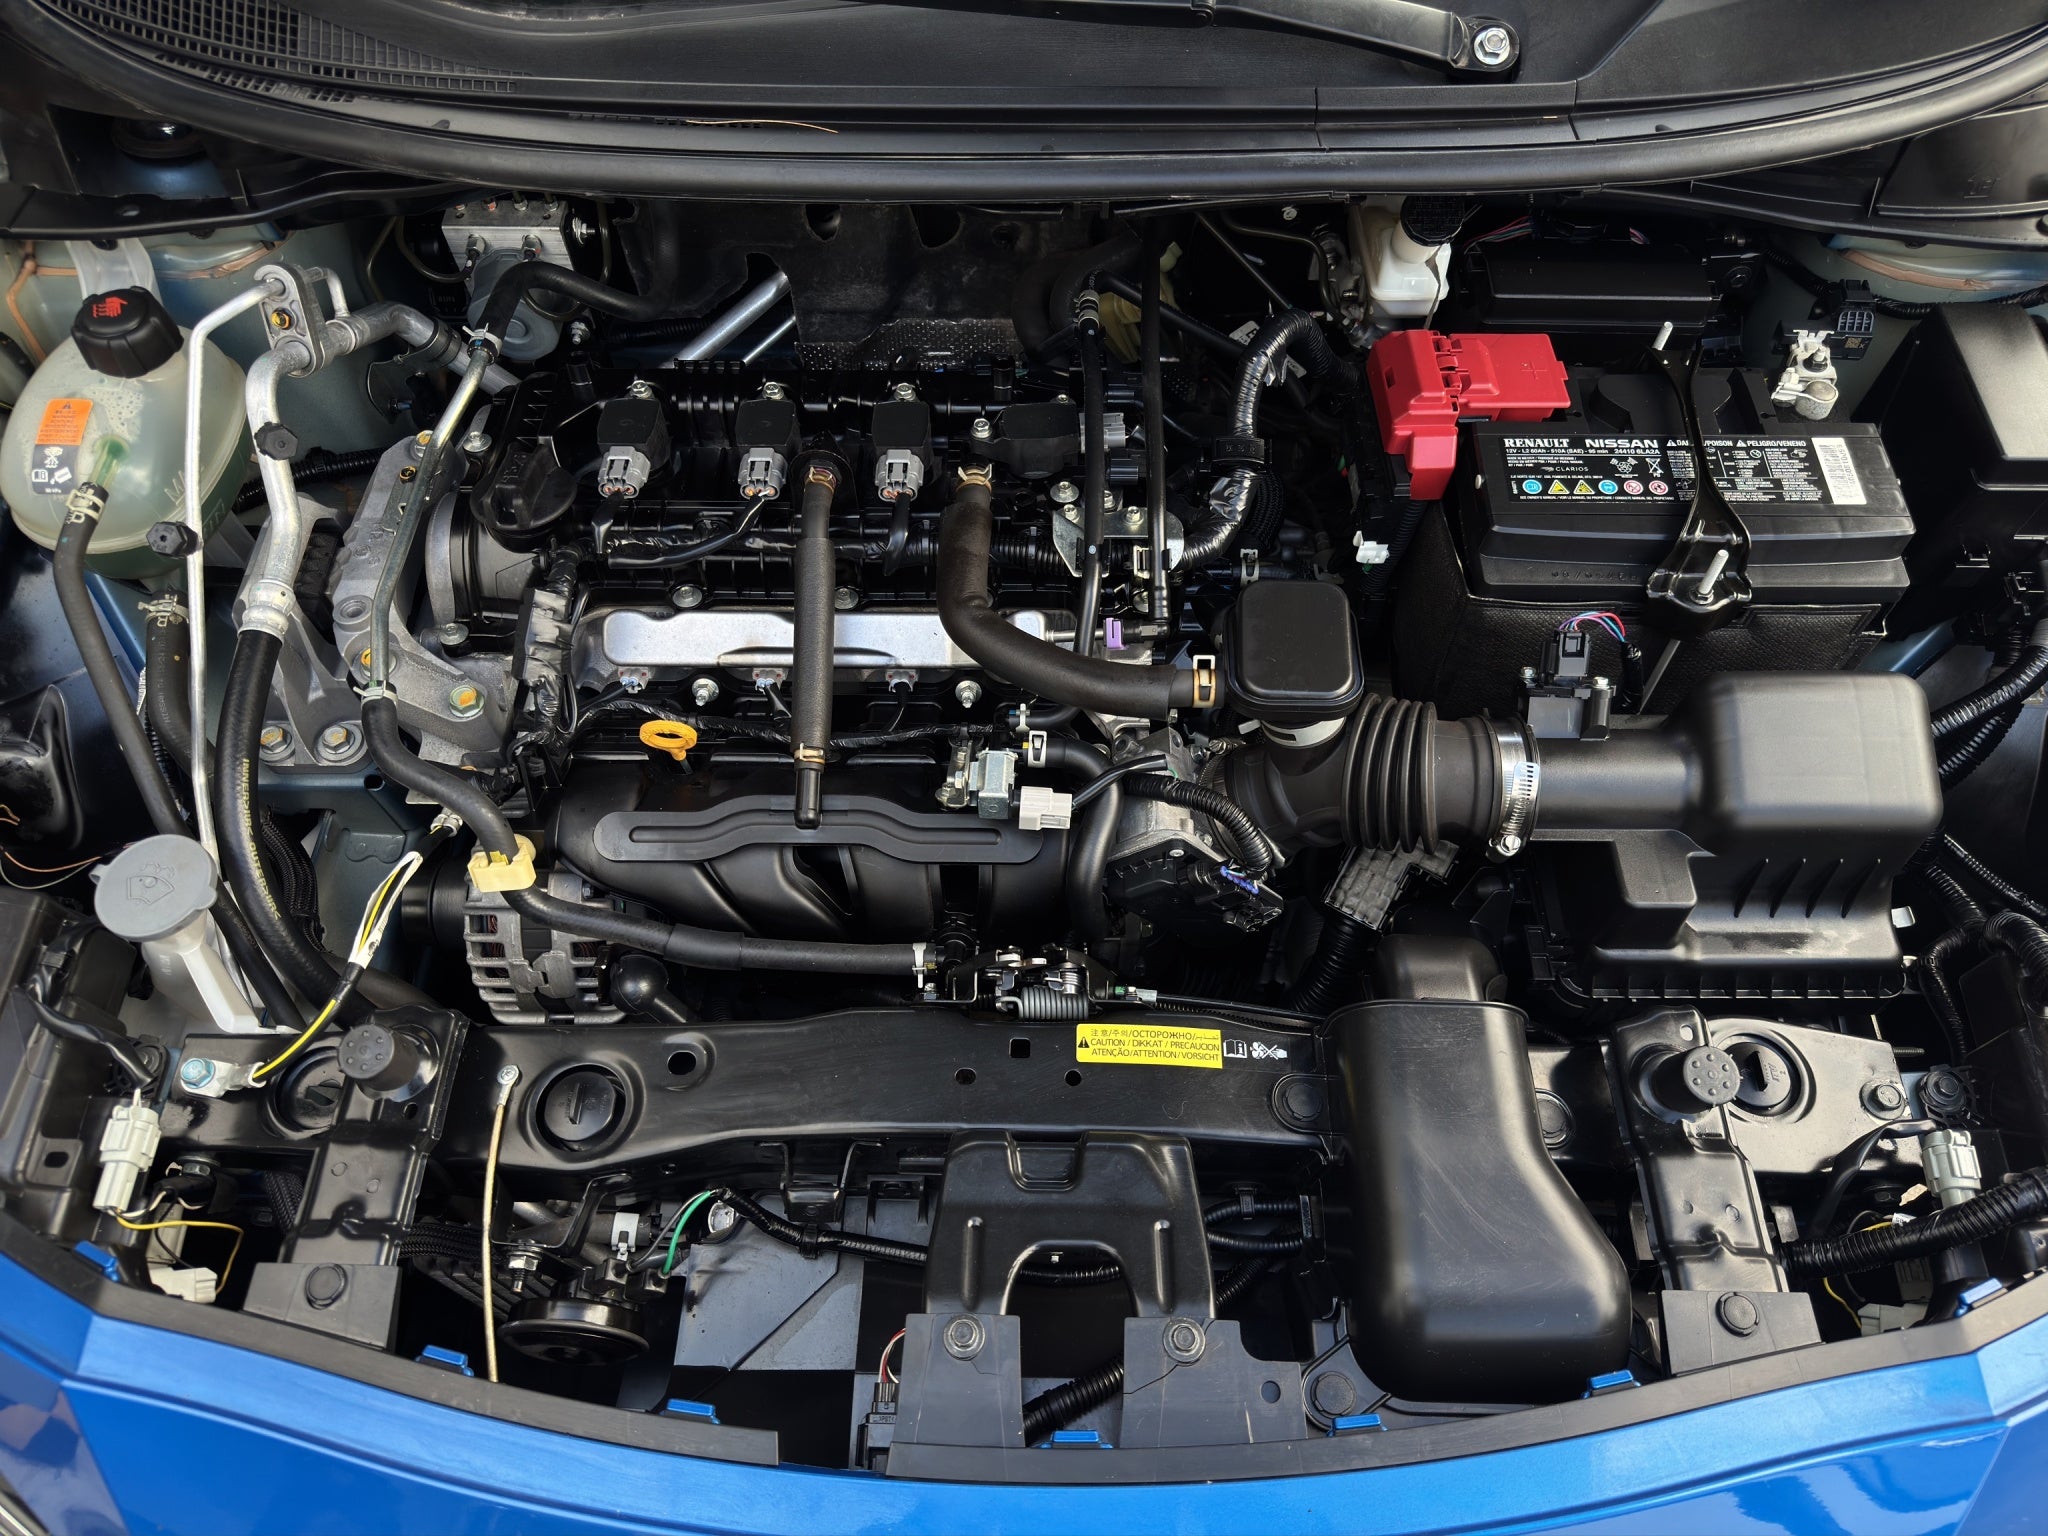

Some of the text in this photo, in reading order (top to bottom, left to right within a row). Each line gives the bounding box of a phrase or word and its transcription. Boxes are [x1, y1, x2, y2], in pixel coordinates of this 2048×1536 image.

[1503, 438, 1569, 448] RENAULT
[1584, 439, 1659, 448] NISSAN
[1090, 1038, 1126, 1047] CAUTION
[1132, 1039, 1163, 1048] DIKKAT
[1170, 1041, 1220, 1052] PRECAUCION
